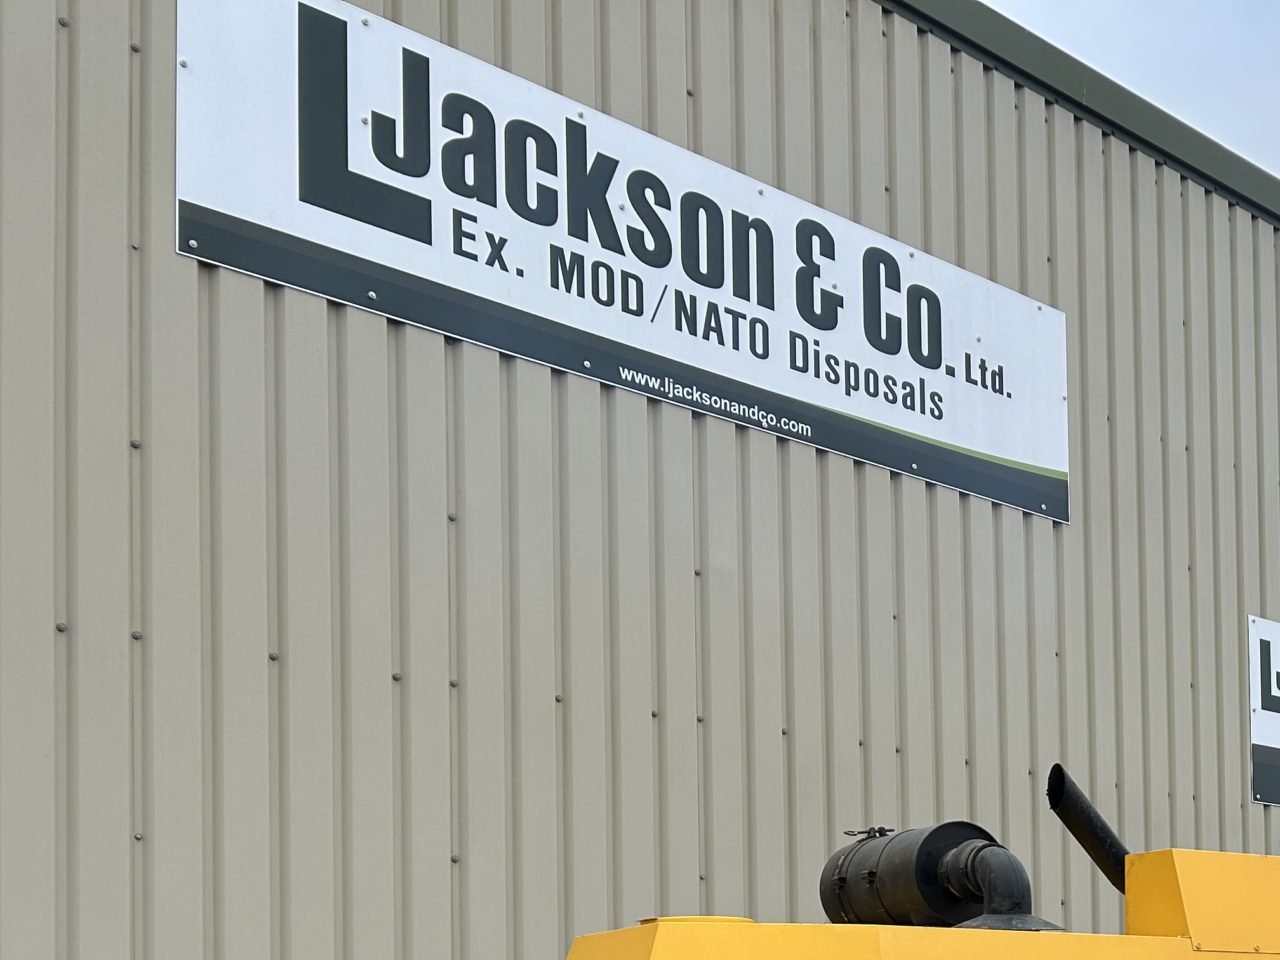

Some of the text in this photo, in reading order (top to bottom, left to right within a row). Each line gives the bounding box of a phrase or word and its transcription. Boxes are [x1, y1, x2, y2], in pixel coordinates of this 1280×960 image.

[452, 208, 525, 279] Ex.
[789, 330, 944, 421] Disposals
[795, 218, 844, 331] &
[862, 246, 956, 378] Co.
[964, 352, 1012, 399] Ltd.
